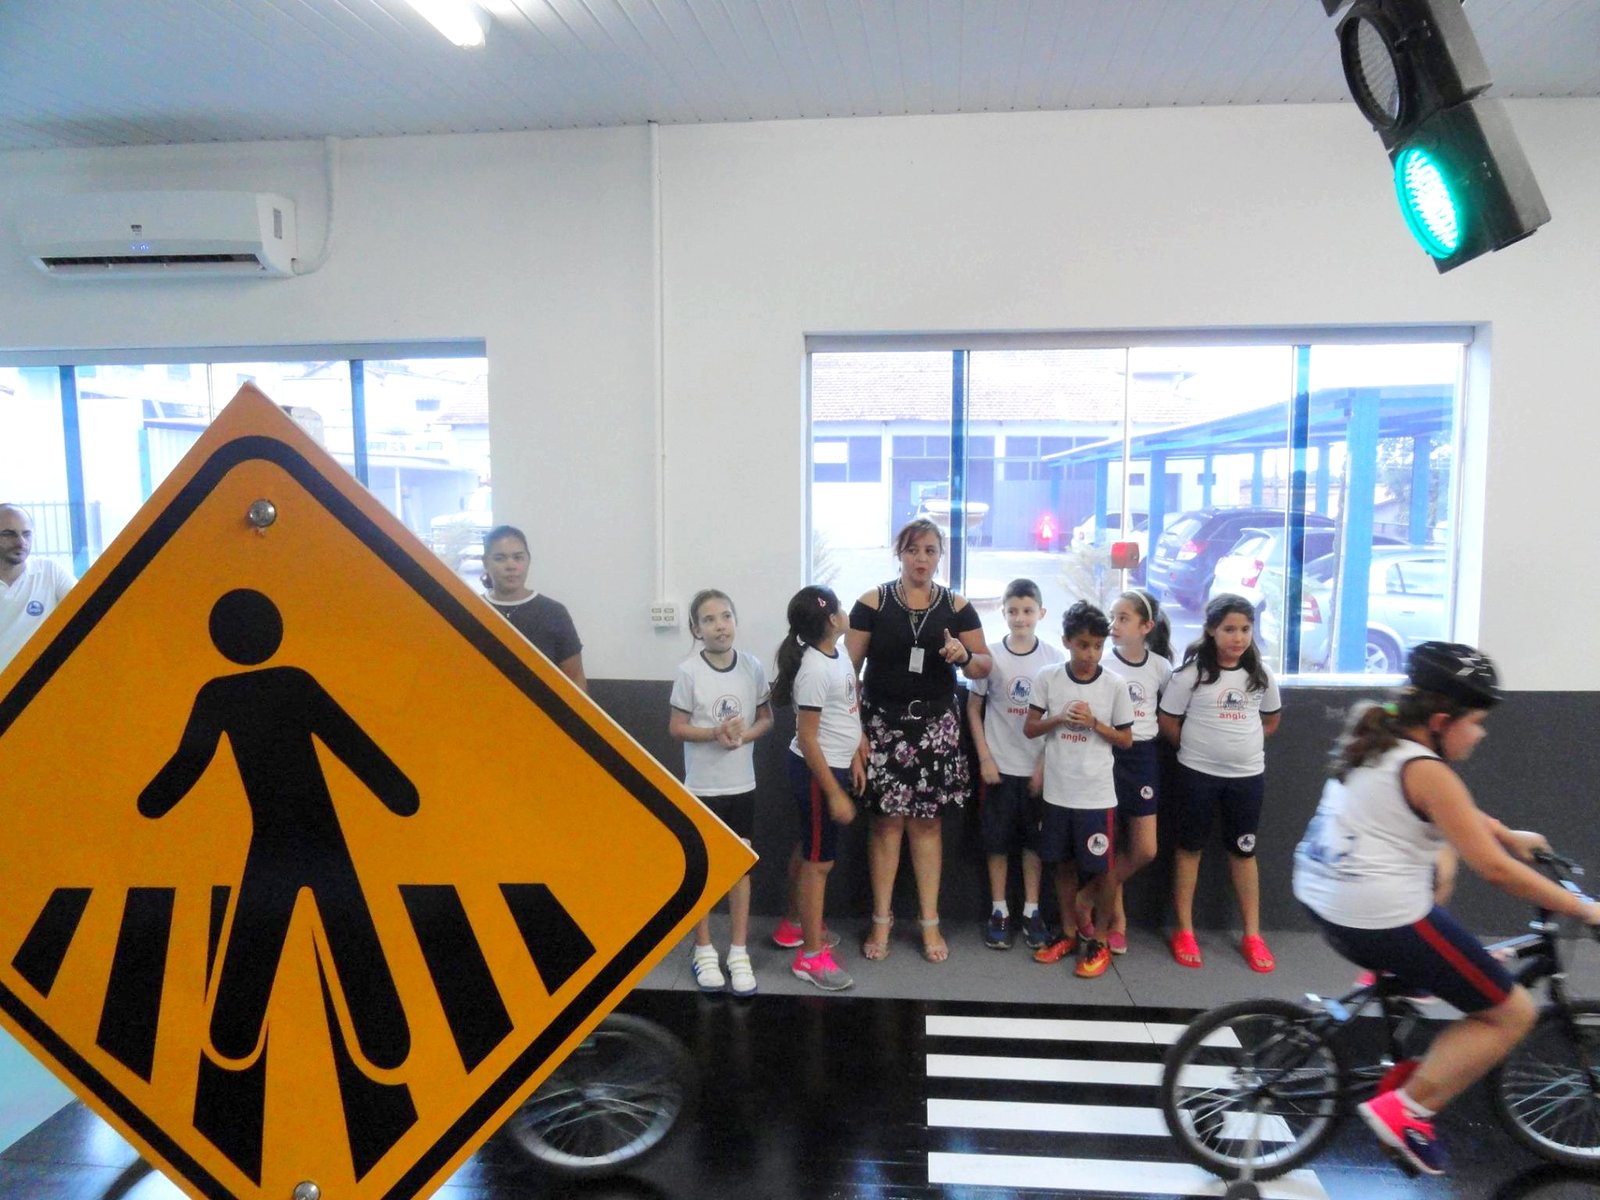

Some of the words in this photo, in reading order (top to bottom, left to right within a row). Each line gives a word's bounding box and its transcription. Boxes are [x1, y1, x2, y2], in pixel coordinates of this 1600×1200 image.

[1007, 706, 1029, 716] angl
[1219, 711, 1247, 720] anglo
[1060, 732, 1087, 743] anglo
